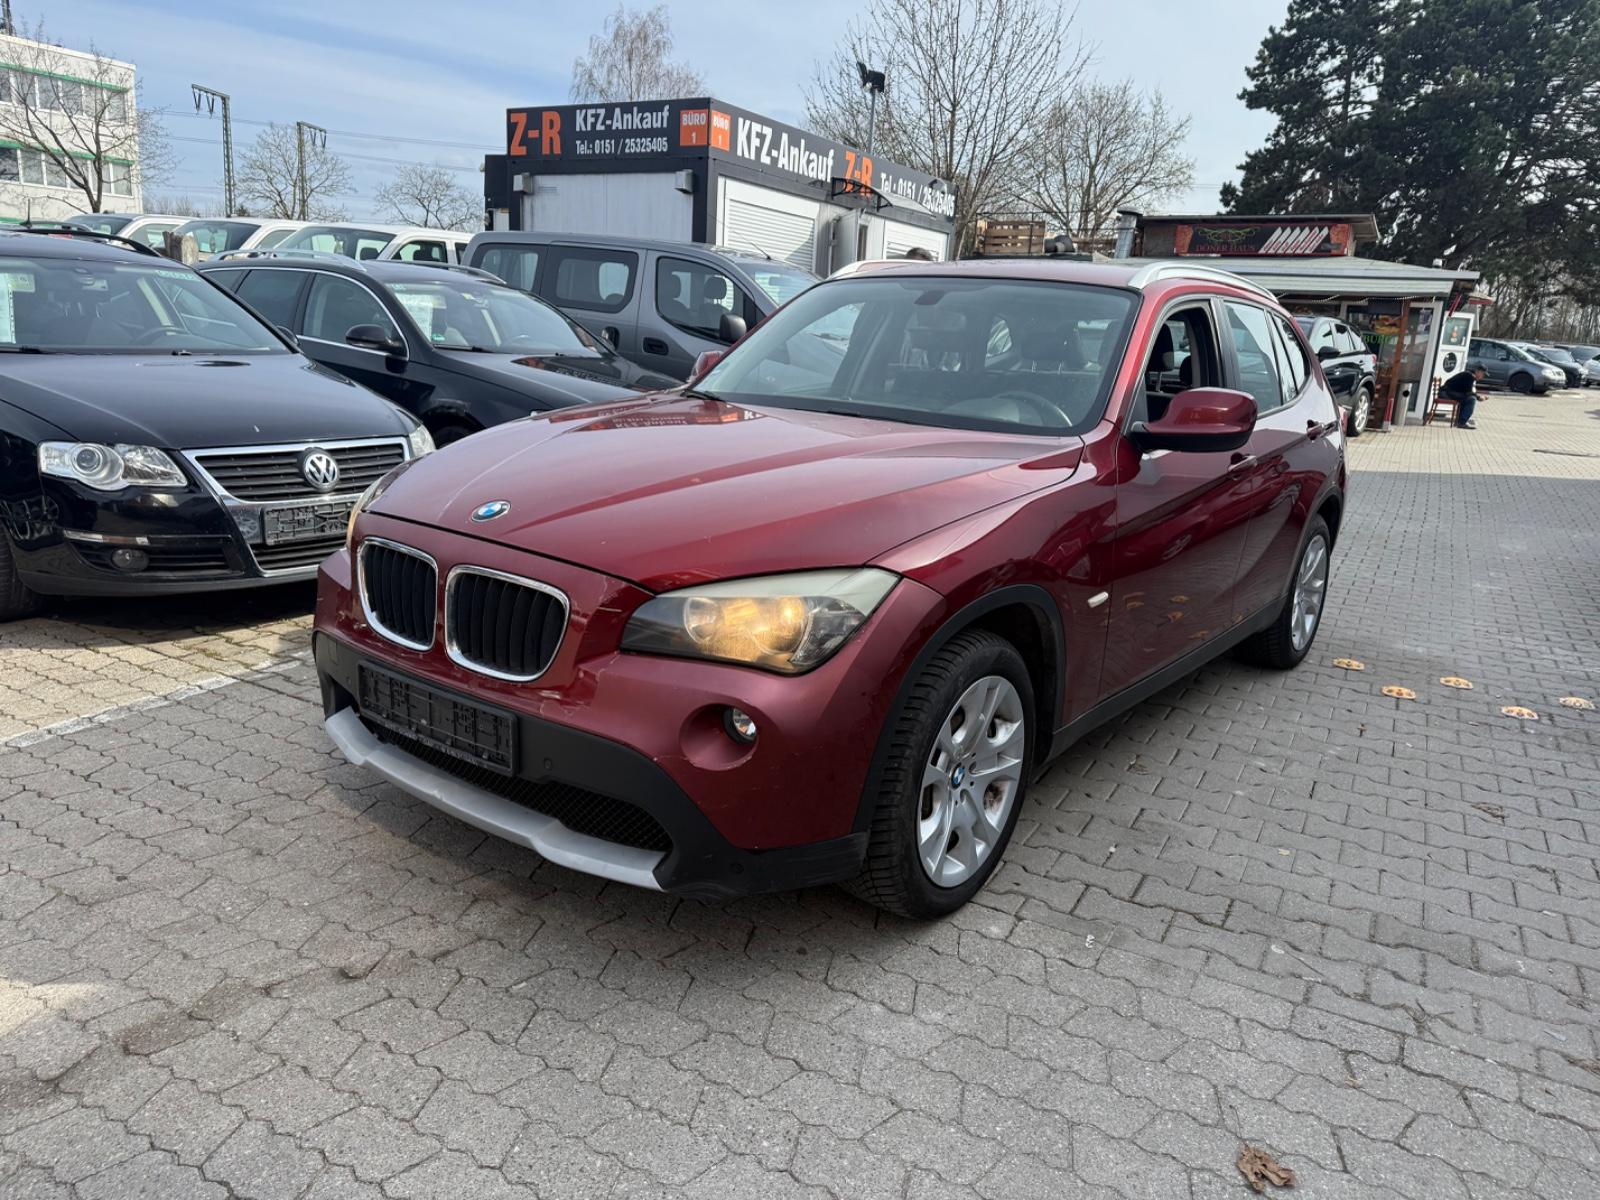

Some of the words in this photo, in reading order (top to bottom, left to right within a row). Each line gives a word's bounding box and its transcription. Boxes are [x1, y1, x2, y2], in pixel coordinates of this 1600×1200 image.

[575, 105, 670, 132] KFZ-Ankauf
[681, 111, 707, 126] BÜRO
[510, 111, 562, 156] Z-R
[691, 131, 697, 144] 1
[575, 140, 593, 155] Tel.:
[594, 138, 615, 154] 0151
[624, 136, 668, 153] 25325405
[736, 117, 835, 183] KFZ-Ankauf
